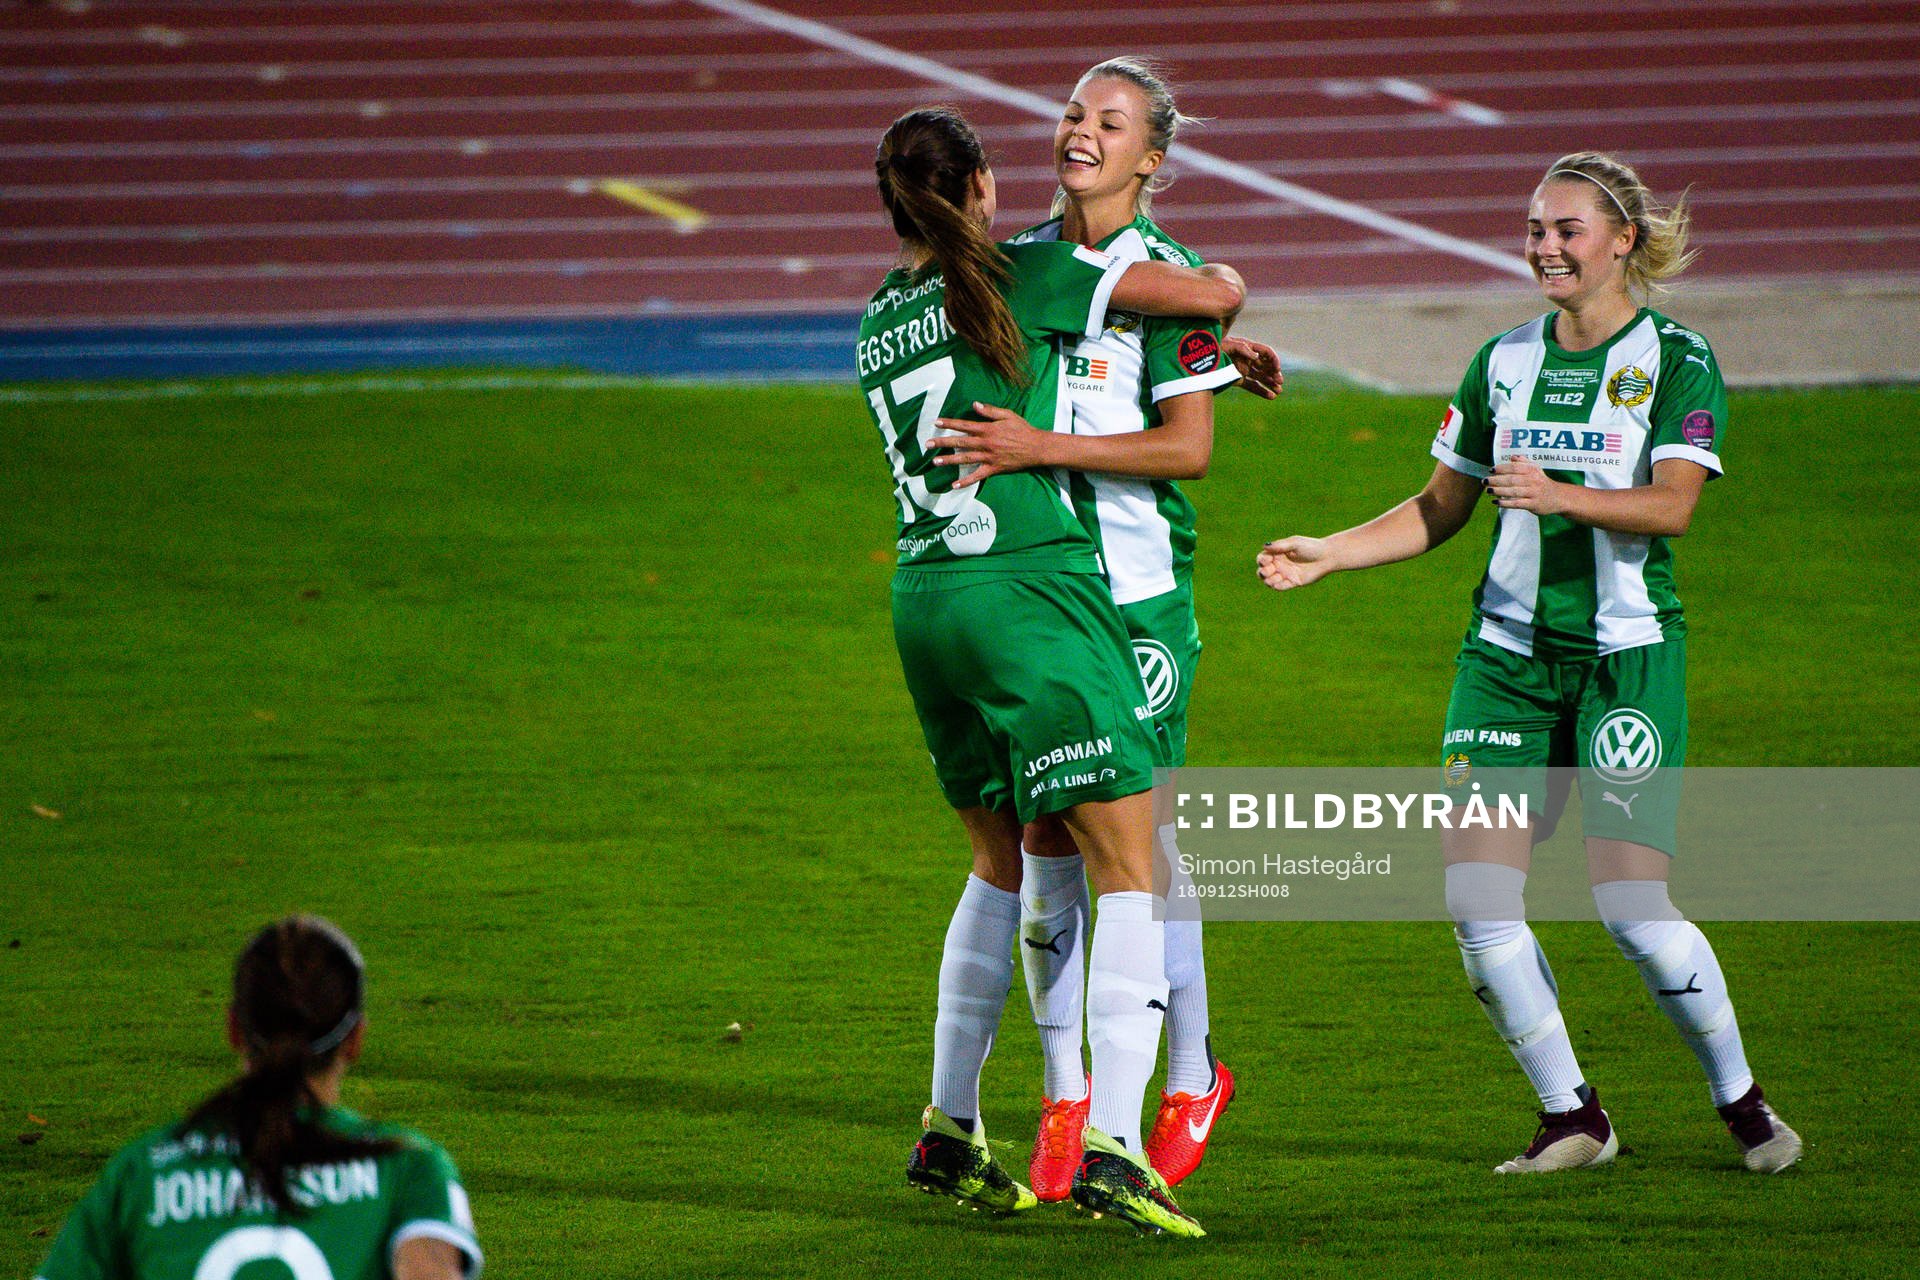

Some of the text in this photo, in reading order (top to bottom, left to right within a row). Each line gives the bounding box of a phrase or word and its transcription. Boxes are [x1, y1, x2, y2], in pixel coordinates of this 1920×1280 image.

[858, 305, 956, 377] EGSTRÖM
[1544, 392, 1585, 406] TELE2
[1509, 428, 1605, 452] PEAB
[1479, 730, 1522, 747] FANS
[1024, 736, 1113, 778] JOBMAN
[1064, 772, 1098, 788] LINE
[148, 1157, 379, 1228] JOHASON
